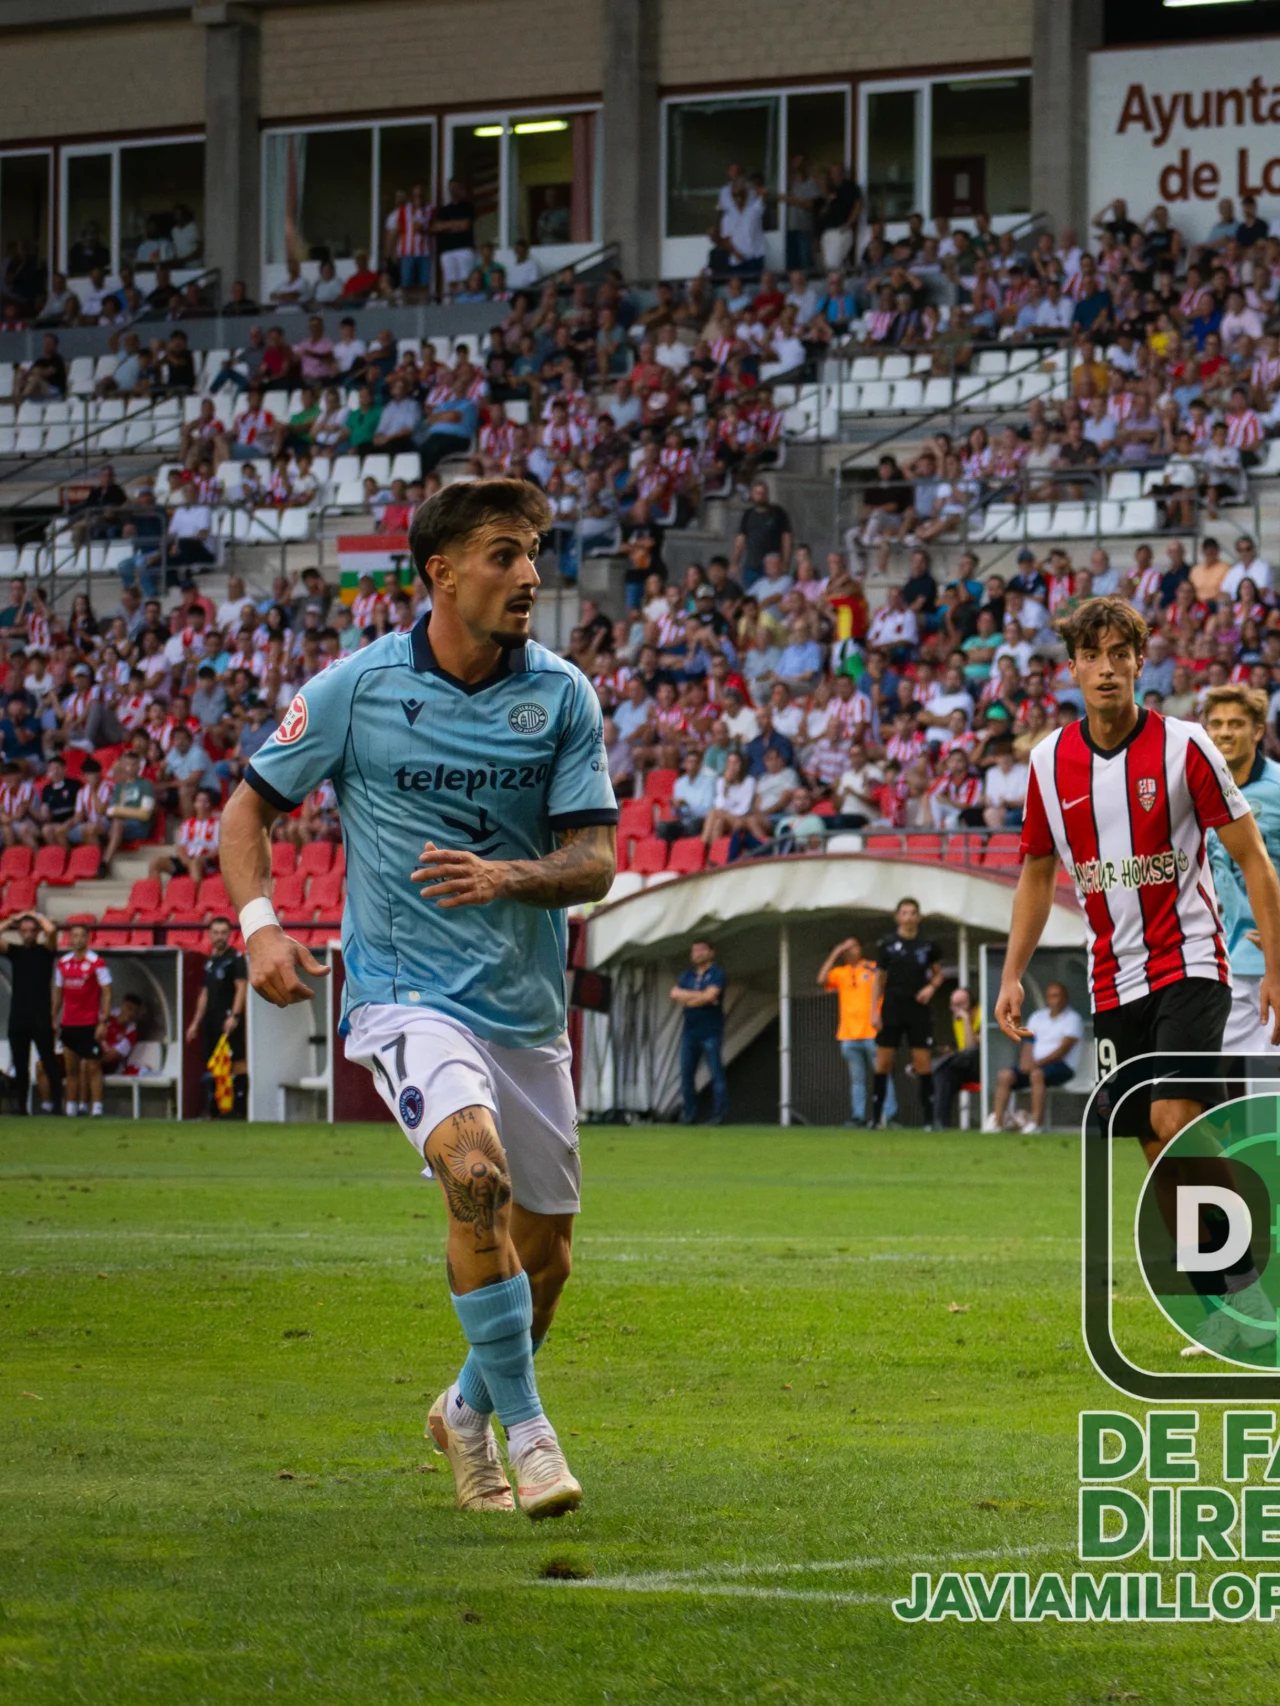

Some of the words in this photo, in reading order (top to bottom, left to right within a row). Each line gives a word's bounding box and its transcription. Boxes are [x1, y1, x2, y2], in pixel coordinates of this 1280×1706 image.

[1158, 148, 1220, 202] de
[393, 762, 549, 801] telepizza
[1121, 849, 1175, 890] HOUSE
